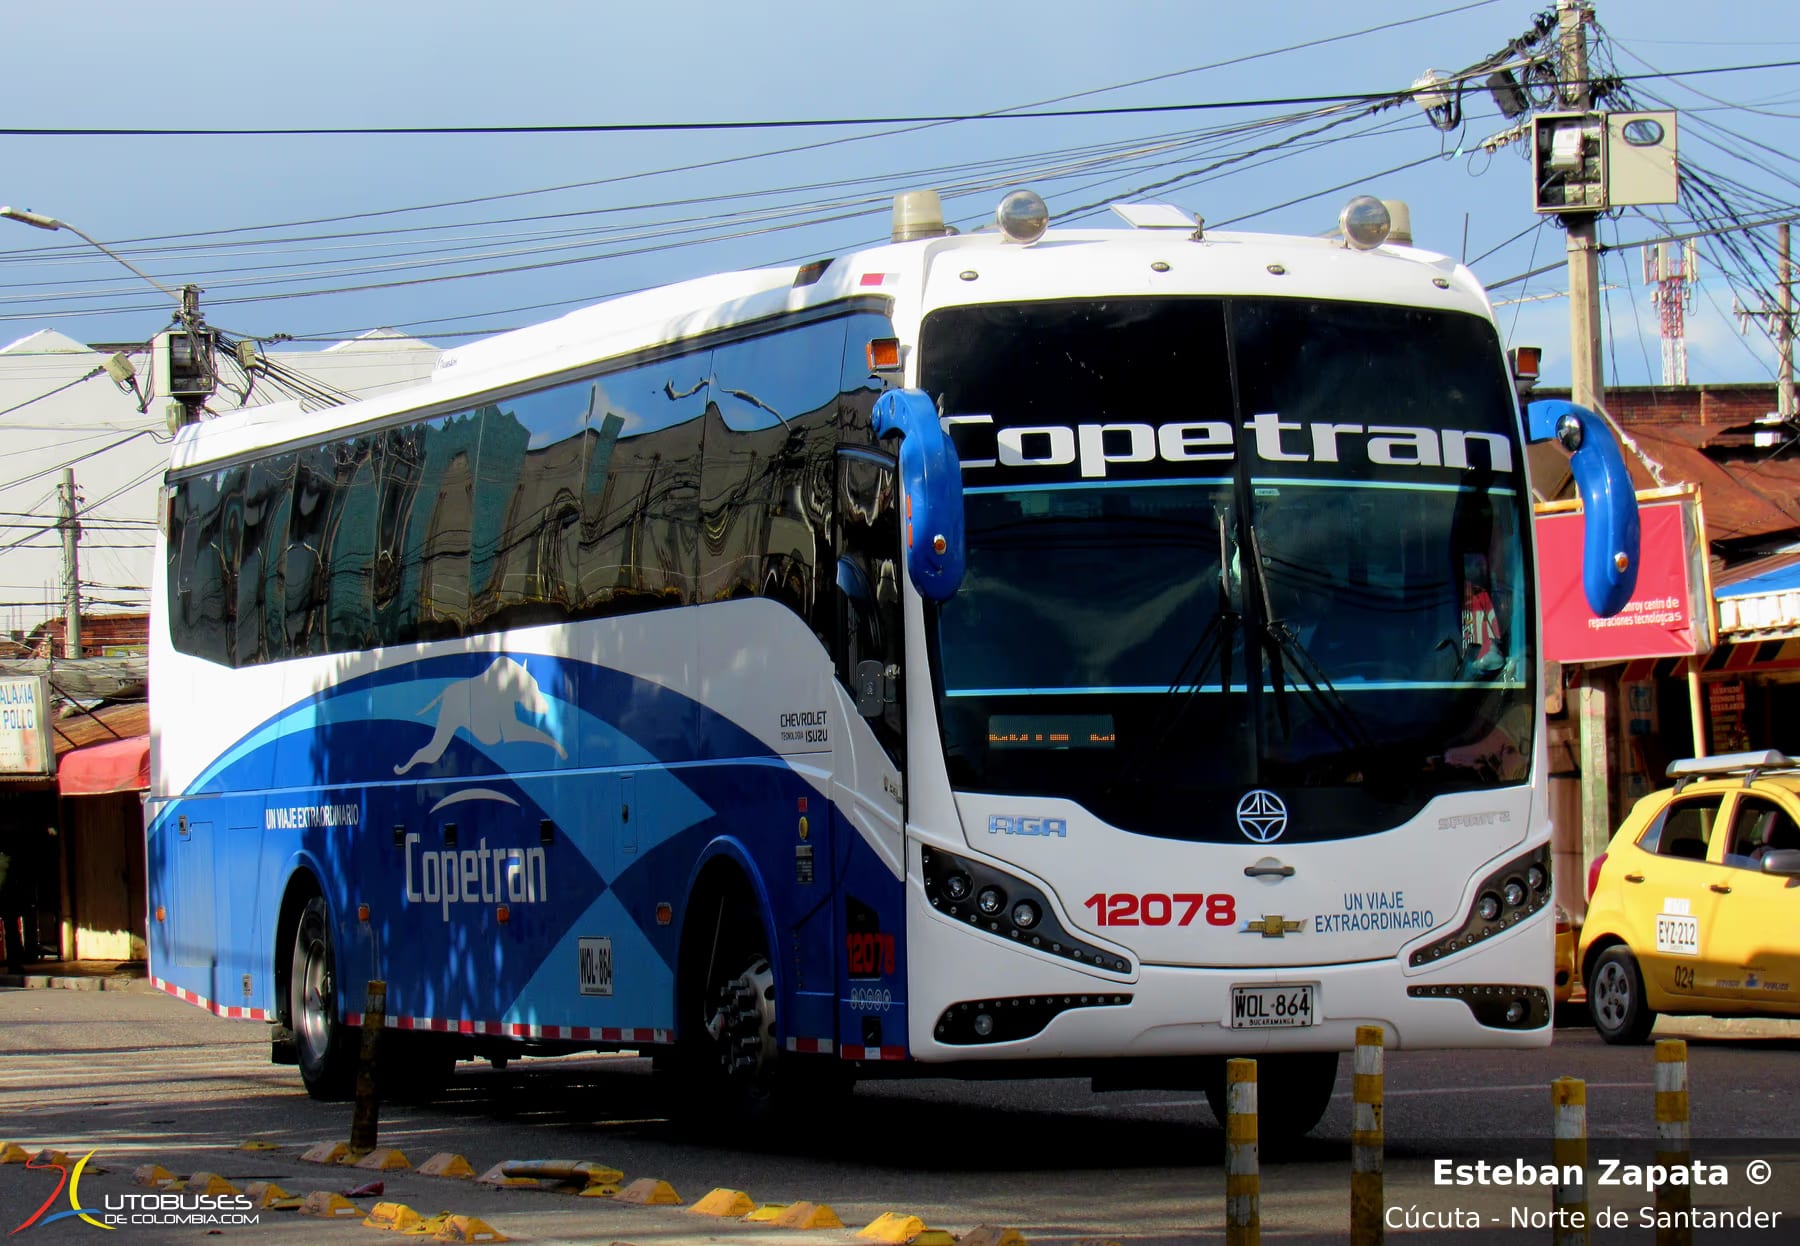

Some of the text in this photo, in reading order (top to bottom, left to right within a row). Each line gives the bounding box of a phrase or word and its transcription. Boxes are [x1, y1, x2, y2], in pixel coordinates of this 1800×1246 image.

[940, 413, 1512, 477] Copetran
[1666, 596, 1679, 609] de
[1588, 615, 1633, 630] reparaciones
[3, 709, 33, 729] POLLO
[780, 711, 828, 728] CHEVROLET
[805, 728, 828, 743] ISUZU
[266, 804, 359, 830] UN VIAJE EXTRAORDINARIO
[988, 815, 1067, 838] AGA
[405, 832, 547, 922] Copetran
[1083, 893, 1236, 926] 12078
[1344, 891, 1404, 910] UN VIAJE
[1315, 910, 1434, 933] EXTRAORDINARIO
[846, 932, 895, 975] 12078
[1674, 965, 1694, 989] 024
